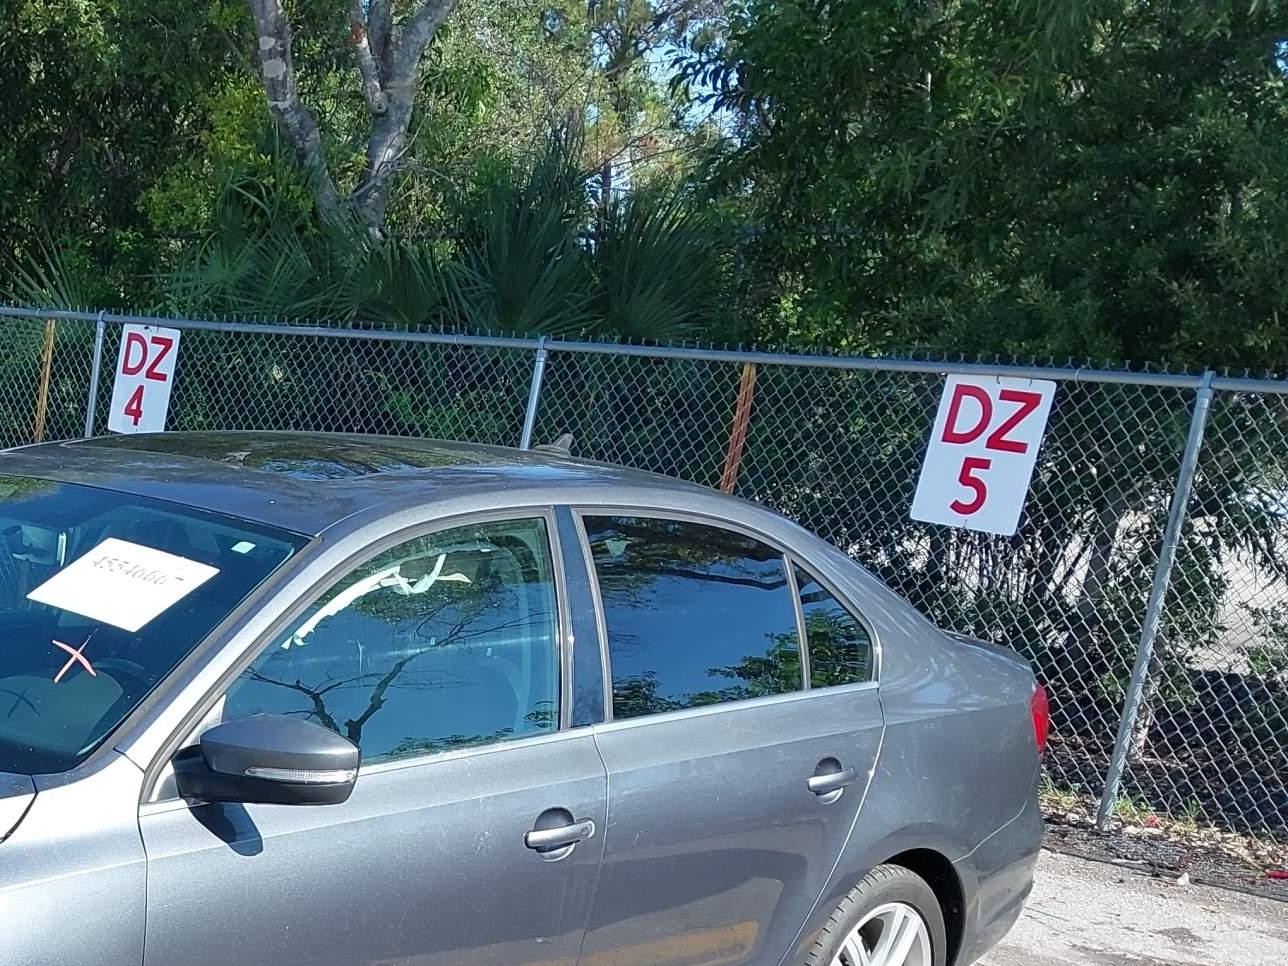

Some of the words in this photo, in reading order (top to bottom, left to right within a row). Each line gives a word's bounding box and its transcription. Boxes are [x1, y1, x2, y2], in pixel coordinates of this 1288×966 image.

[122, 332, 173, 381] DZ
[123, 384, 145, 426] 4
[941, 383, 1043, 454] DZ
[949, 456, 992, 516] 5
